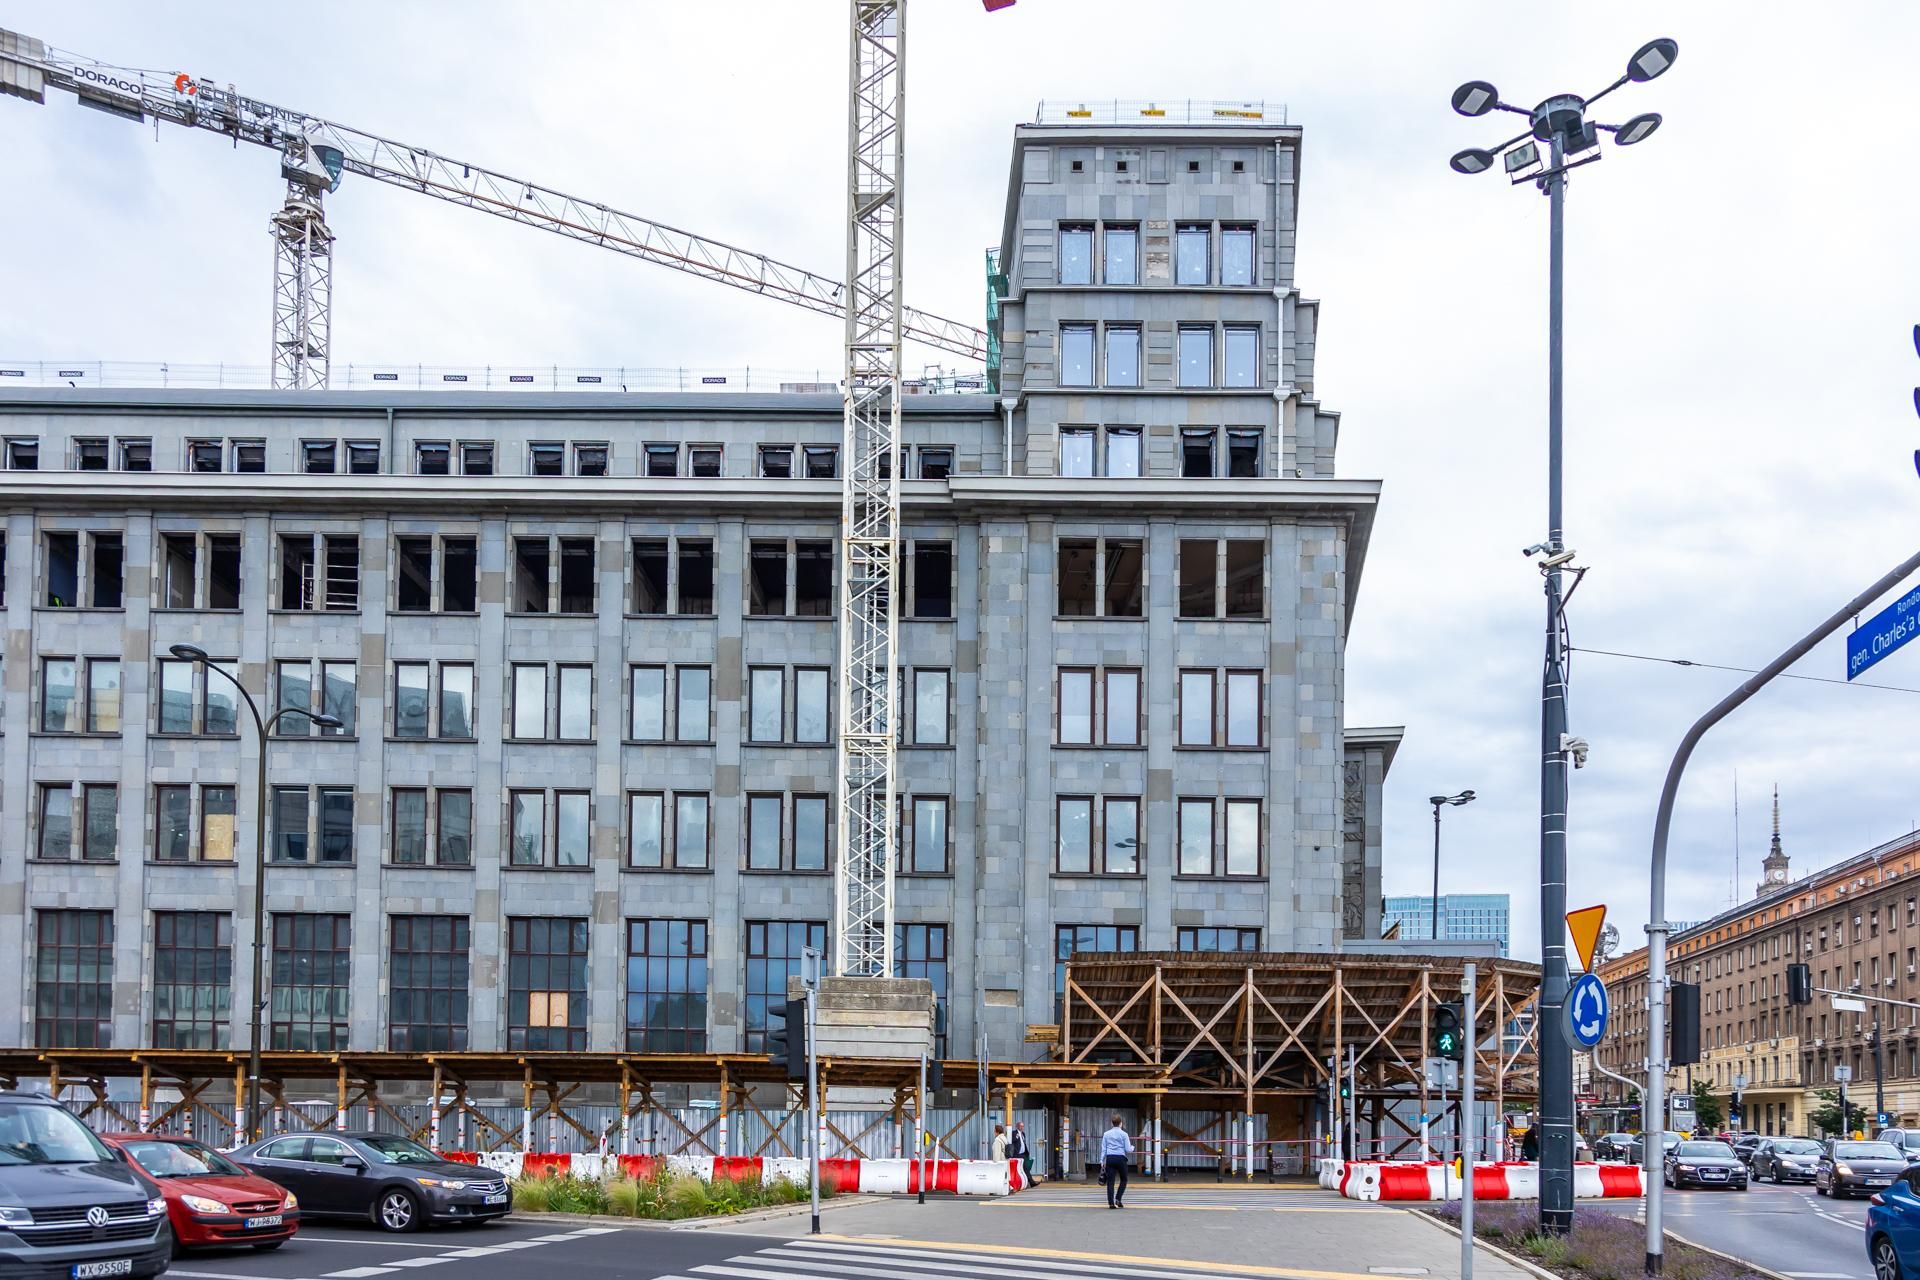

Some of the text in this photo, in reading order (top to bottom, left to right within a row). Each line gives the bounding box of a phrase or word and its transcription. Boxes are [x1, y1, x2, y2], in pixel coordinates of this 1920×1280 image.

[74, 66, 141, 94] DORACO
[1897, 591, 1920, 616] Rondo
[1851, 648, 1870, 675] gen.
[1872, 615, 1915, 655] Charles'a
[80, 1260, 129, 1276] WX 9550E
